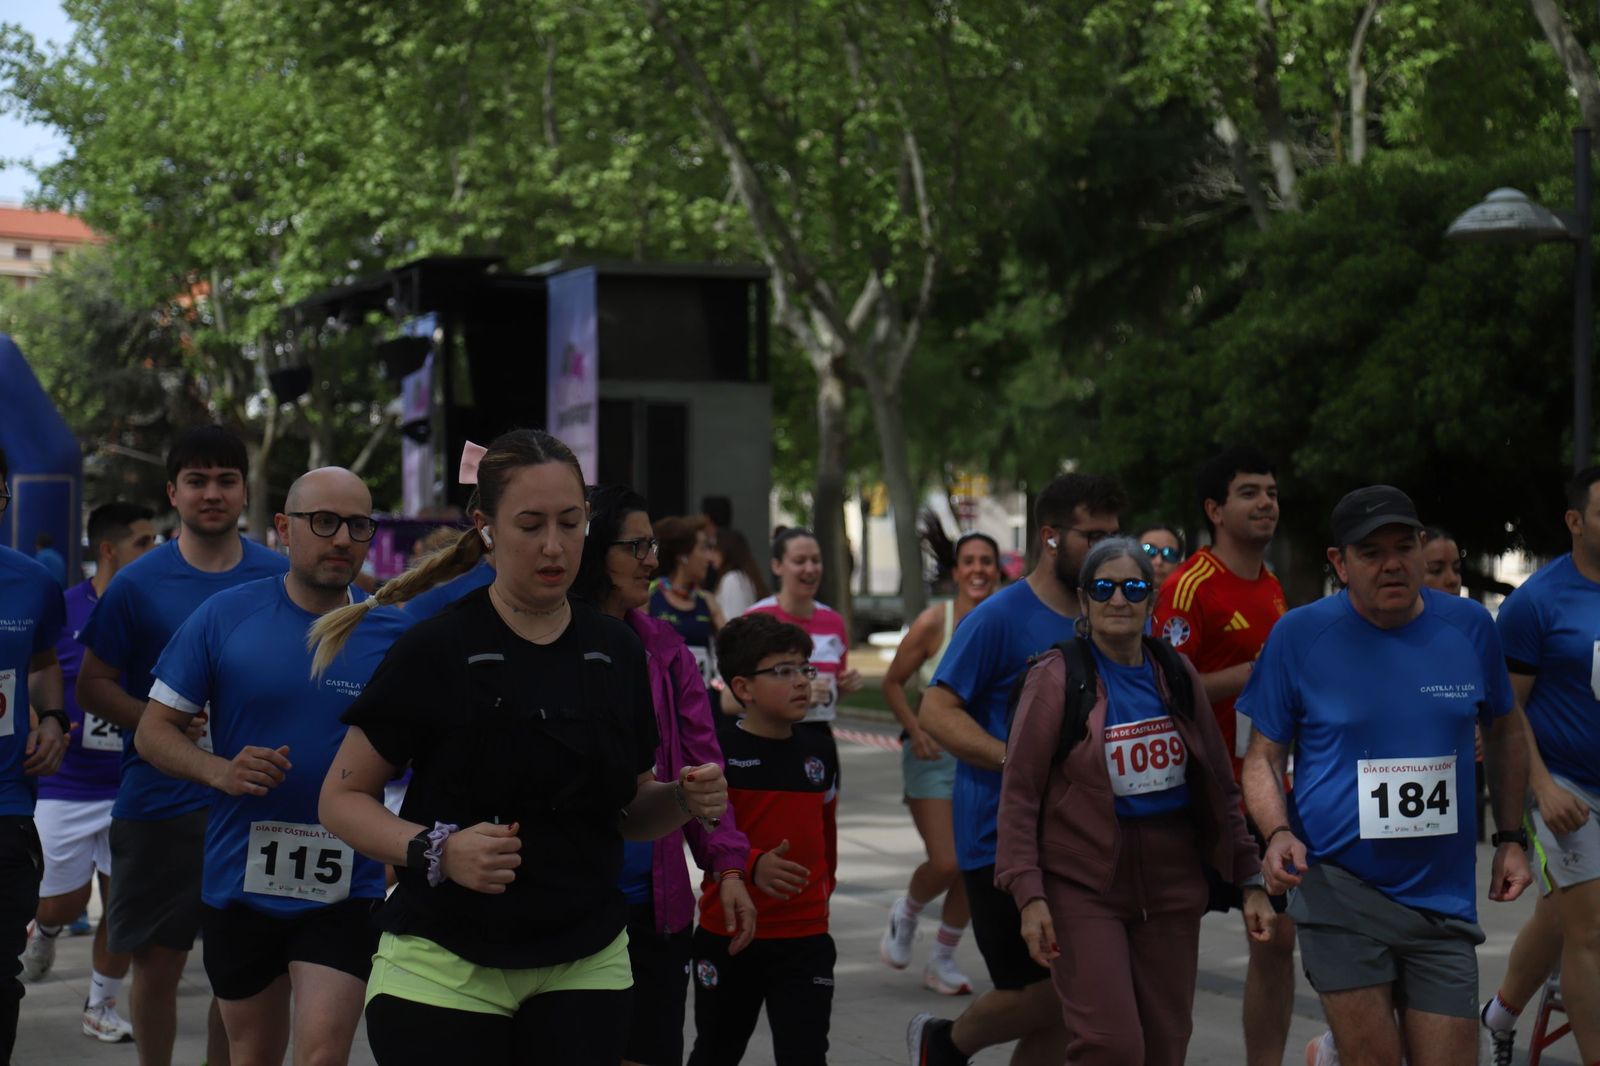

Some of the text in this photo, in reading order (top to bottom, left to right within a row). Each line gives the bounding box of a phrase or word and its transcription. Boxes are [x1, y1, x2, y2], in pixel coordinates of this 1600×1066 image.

[325, 679, 361, 690] CASTILLA
[1420, 685, 1454, 693] CASTILLA
[1105, 729, 1119, 739] DÍA
[1120, 729, 1130, 737] DE
[1131, 723, 1162, 735] CASTILLA
[1111, 736, 1185, 776] 1089
[1363, 764, 1377, 773] DÍA
[1391, 765, 1426, 773] CASTILLA
[1434, 761, 1451, 770] LEÓN
[1371, 780, 1449, 818] 184
[284, 827, 320, 838] CASTILLA
[260, 841, 342, 884] 115
